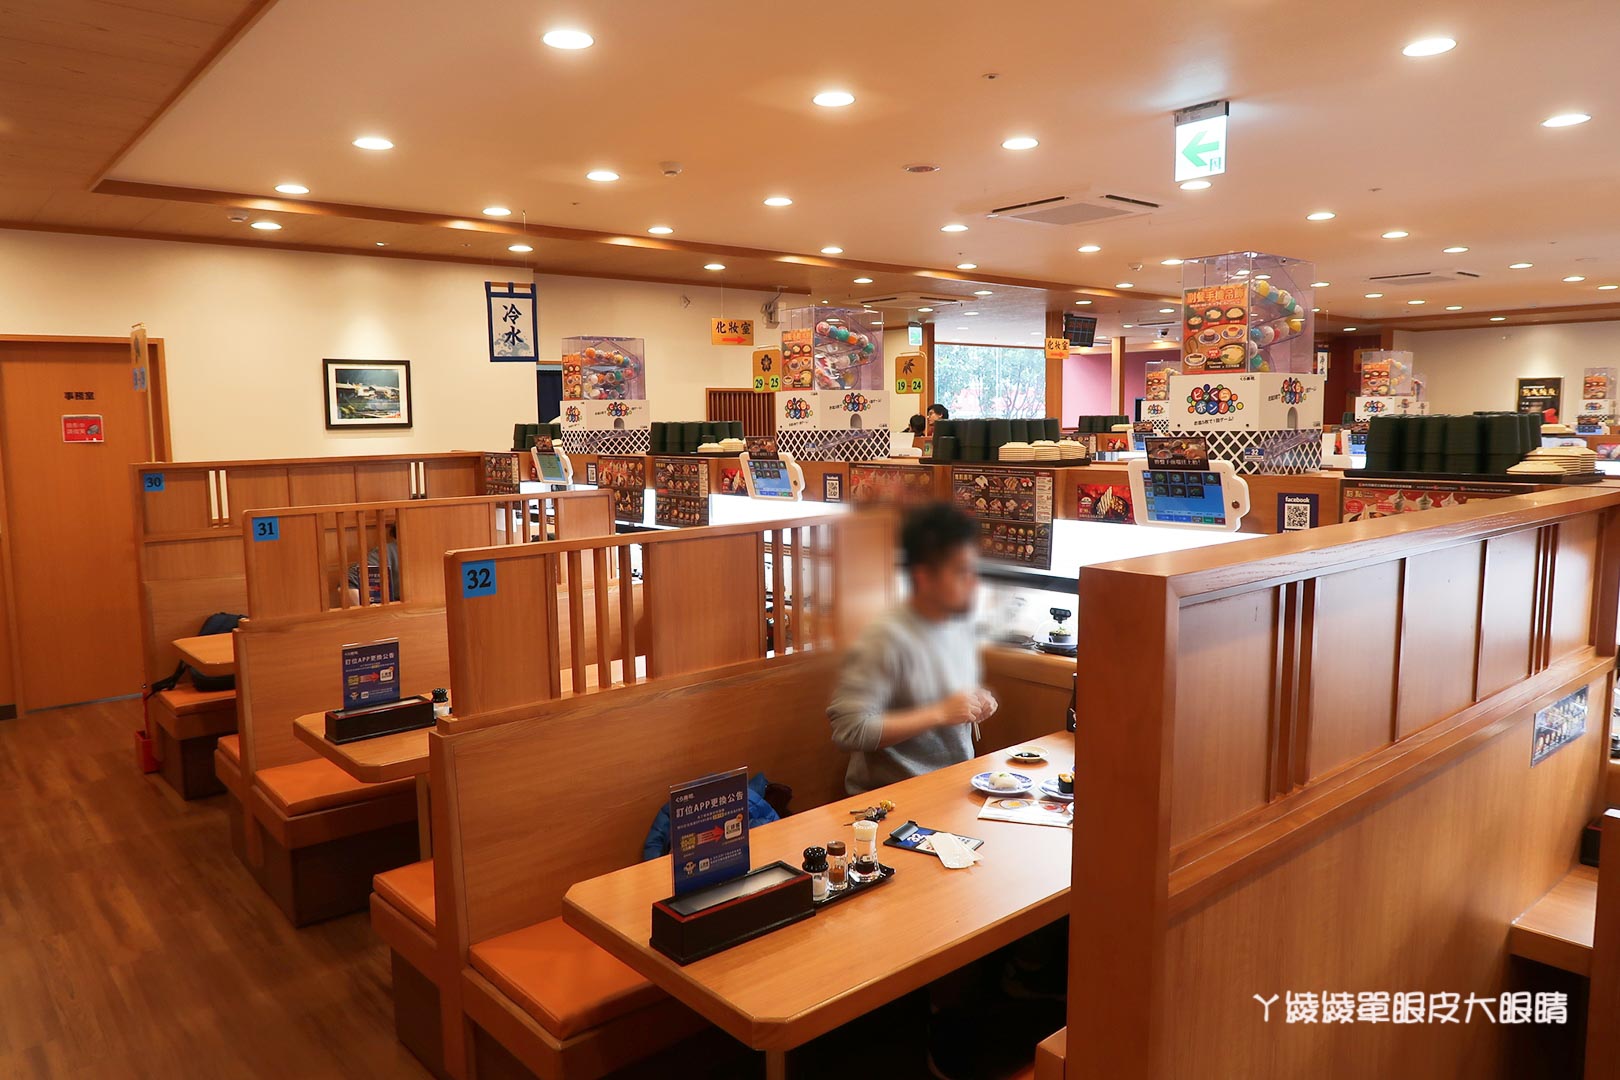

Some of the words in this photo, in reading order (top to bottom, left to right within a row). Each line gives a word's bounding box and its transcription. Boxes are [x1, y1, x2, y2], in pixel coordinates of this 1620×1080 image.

[502, 303, 524, 346] 冷水
[716, 321, 752, 335] 化妝室
[755, 378, 764, 389] 29
[770, 376, 779, 387] 25
[897, 381, 906, 391] 19
[913, 379, 922, 390] 24
[146, 477, 161, 488] 30
[1285, 495, 1311, 503] facebook
[257, 522, 275, 536] 31
[466, 568, 492, 590] 32
[675, 791, 744, 818] 訂位APP更換公告
